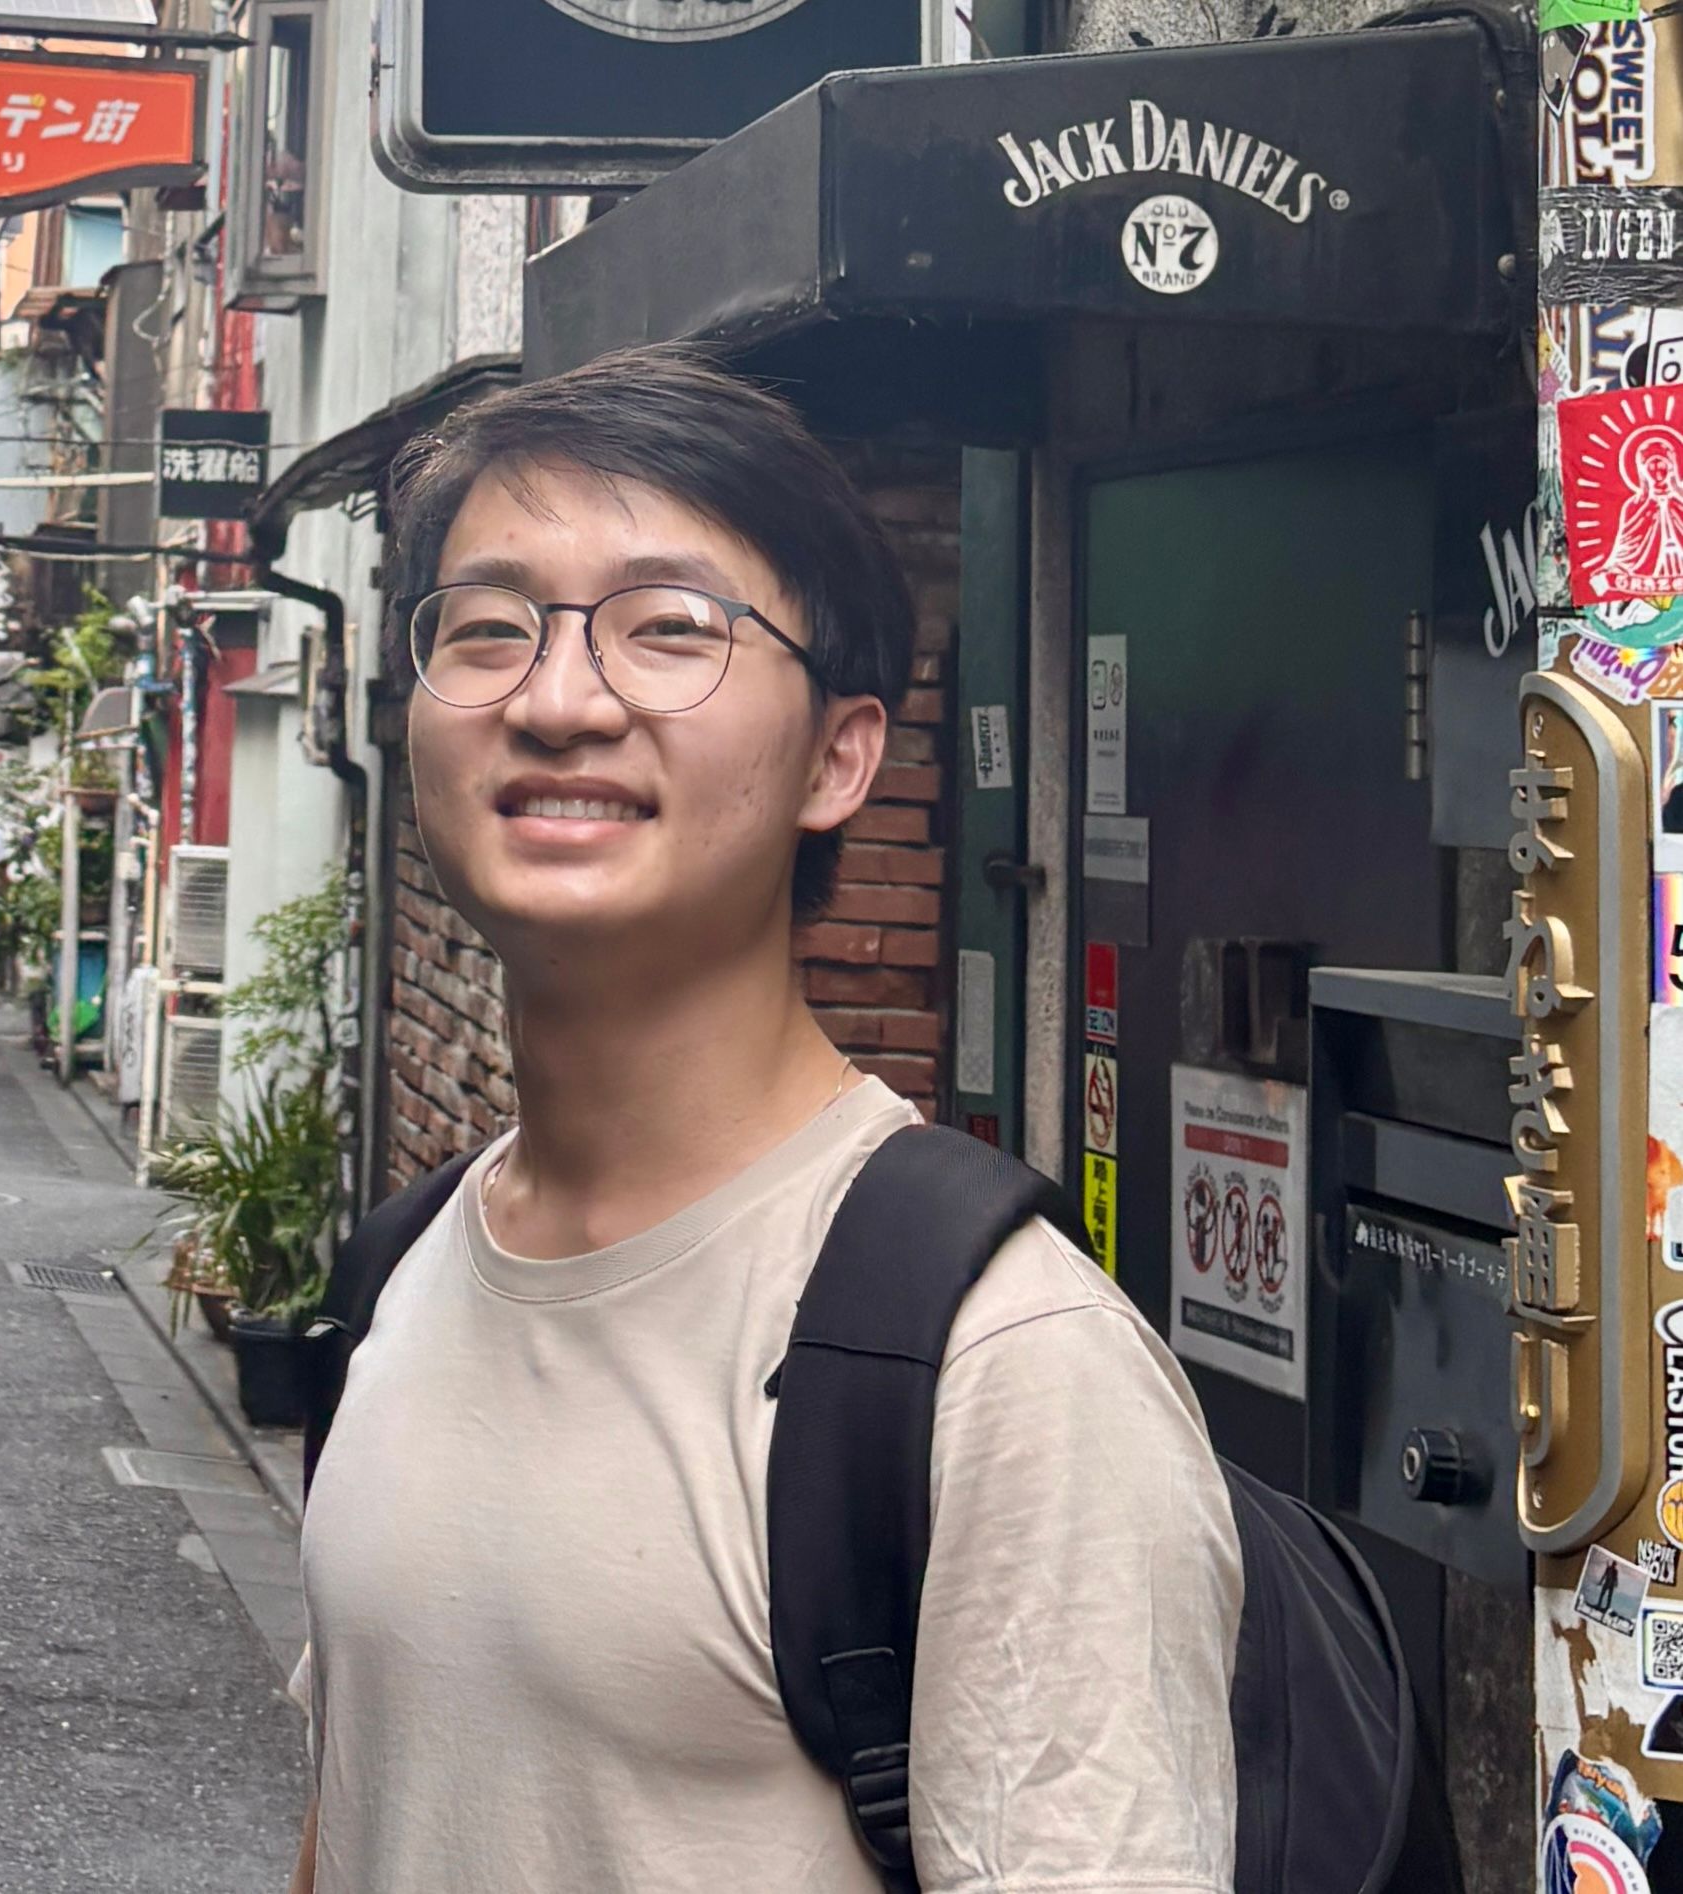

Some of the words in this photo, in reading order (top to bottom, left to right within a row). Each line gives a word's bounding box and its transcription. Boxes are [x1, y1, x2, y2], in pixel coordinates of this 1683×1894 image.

[997, 118, 1125, 208] JACK
[1152, 203, 1190, 218] OLD
[1141, 270, 1197, 288] BRAND
